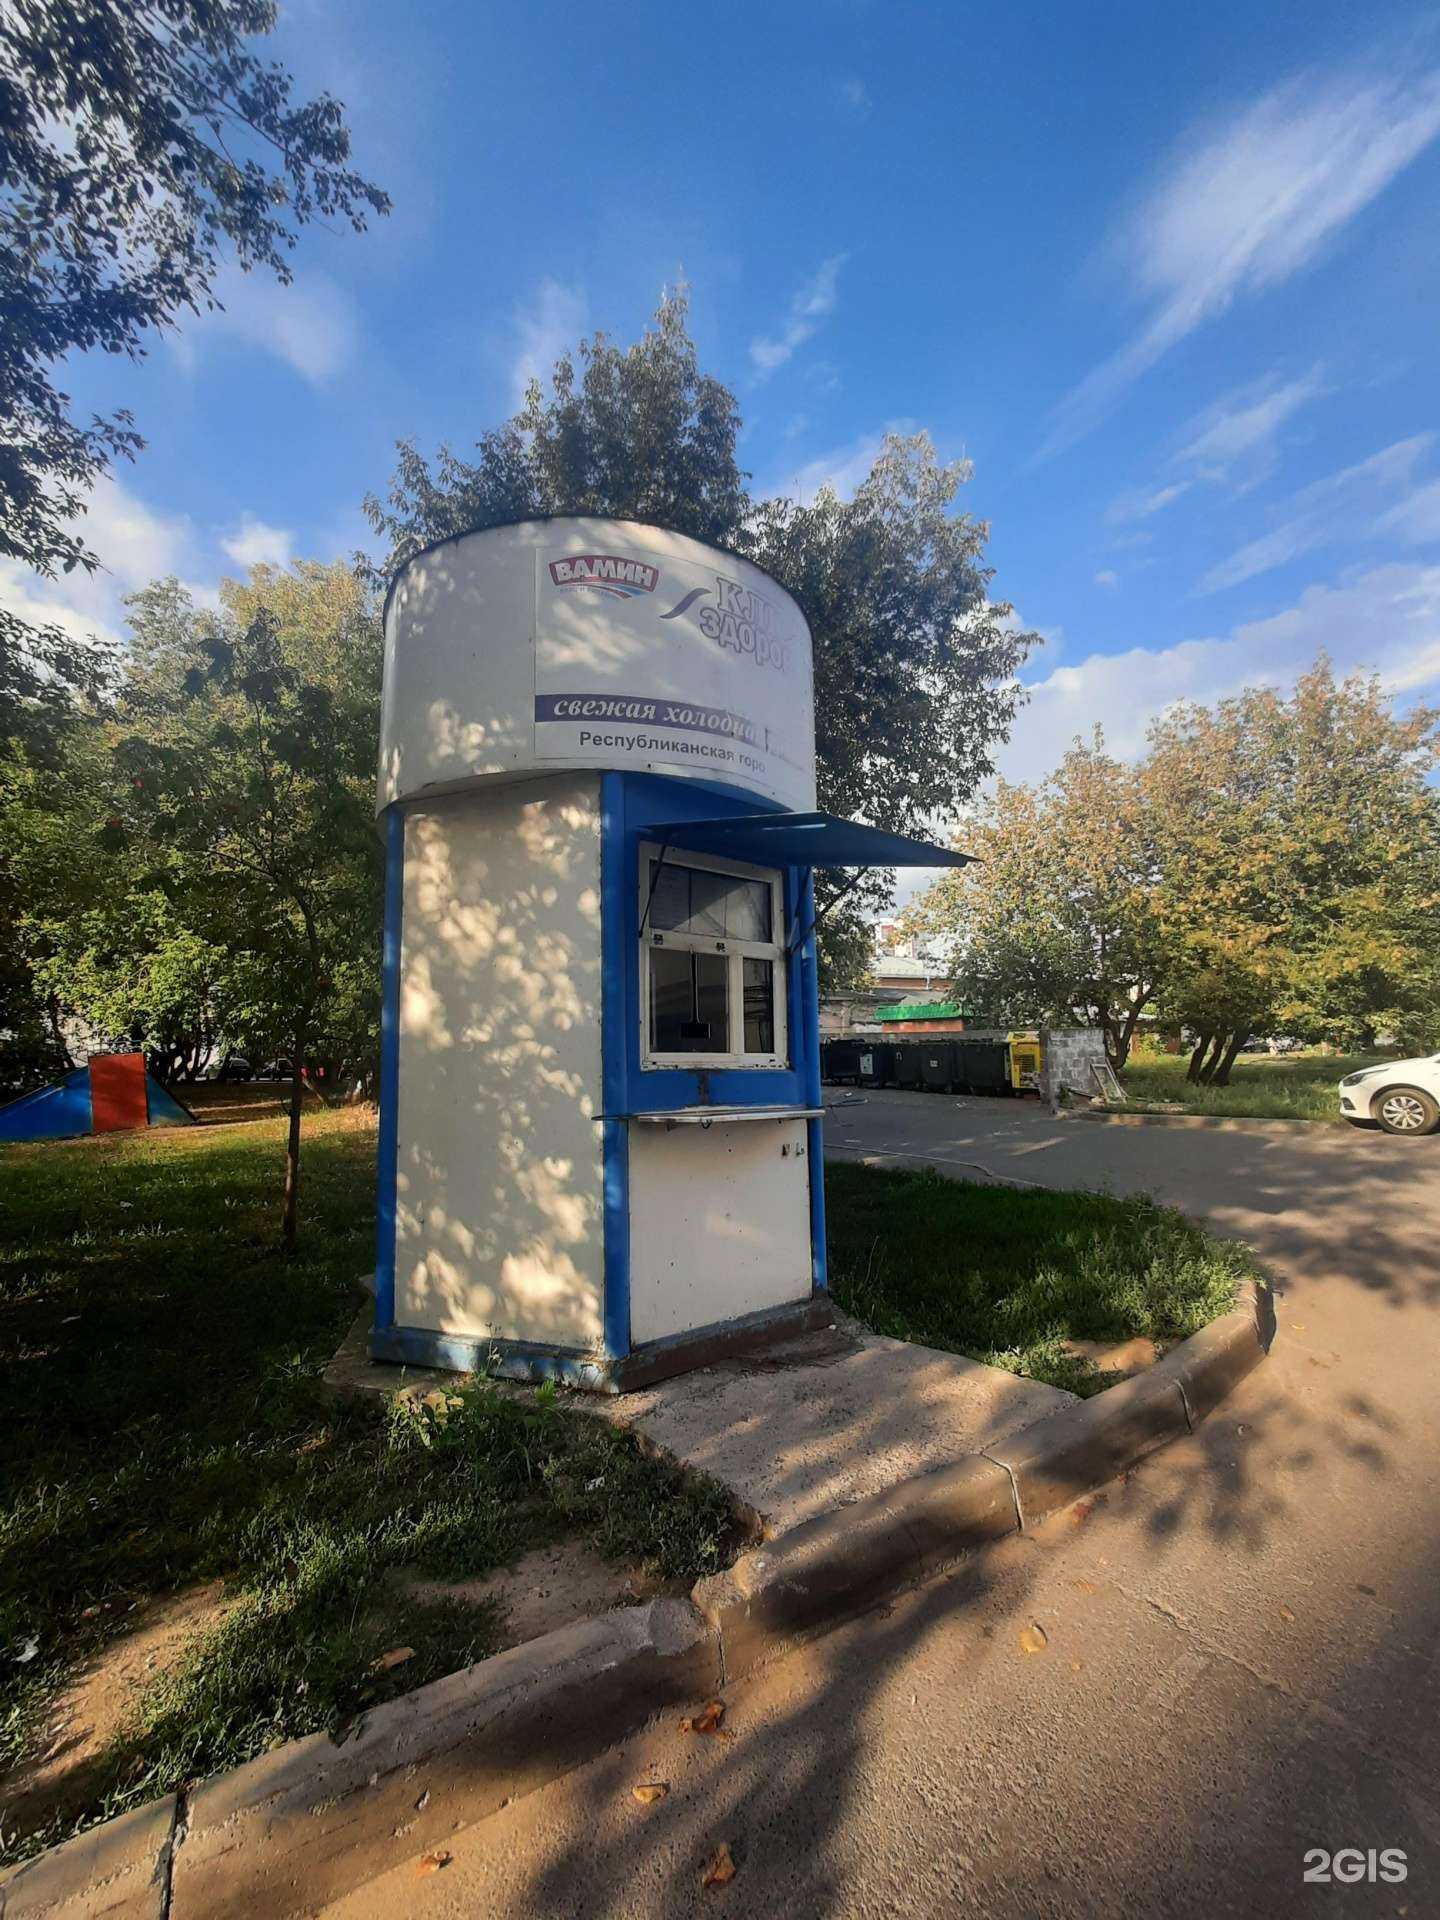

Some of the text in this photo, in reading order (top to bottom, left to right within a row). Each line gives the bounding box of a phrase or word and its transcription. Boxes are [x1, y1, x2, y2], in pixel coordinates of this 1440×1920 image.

[554, 558, 653, 587] ВАМИН
[699, 604, 787, 668] ЗДОРО
[553, 699, 764, 742] свежая холодна
[579, 730, 735, 761] Республиканская
